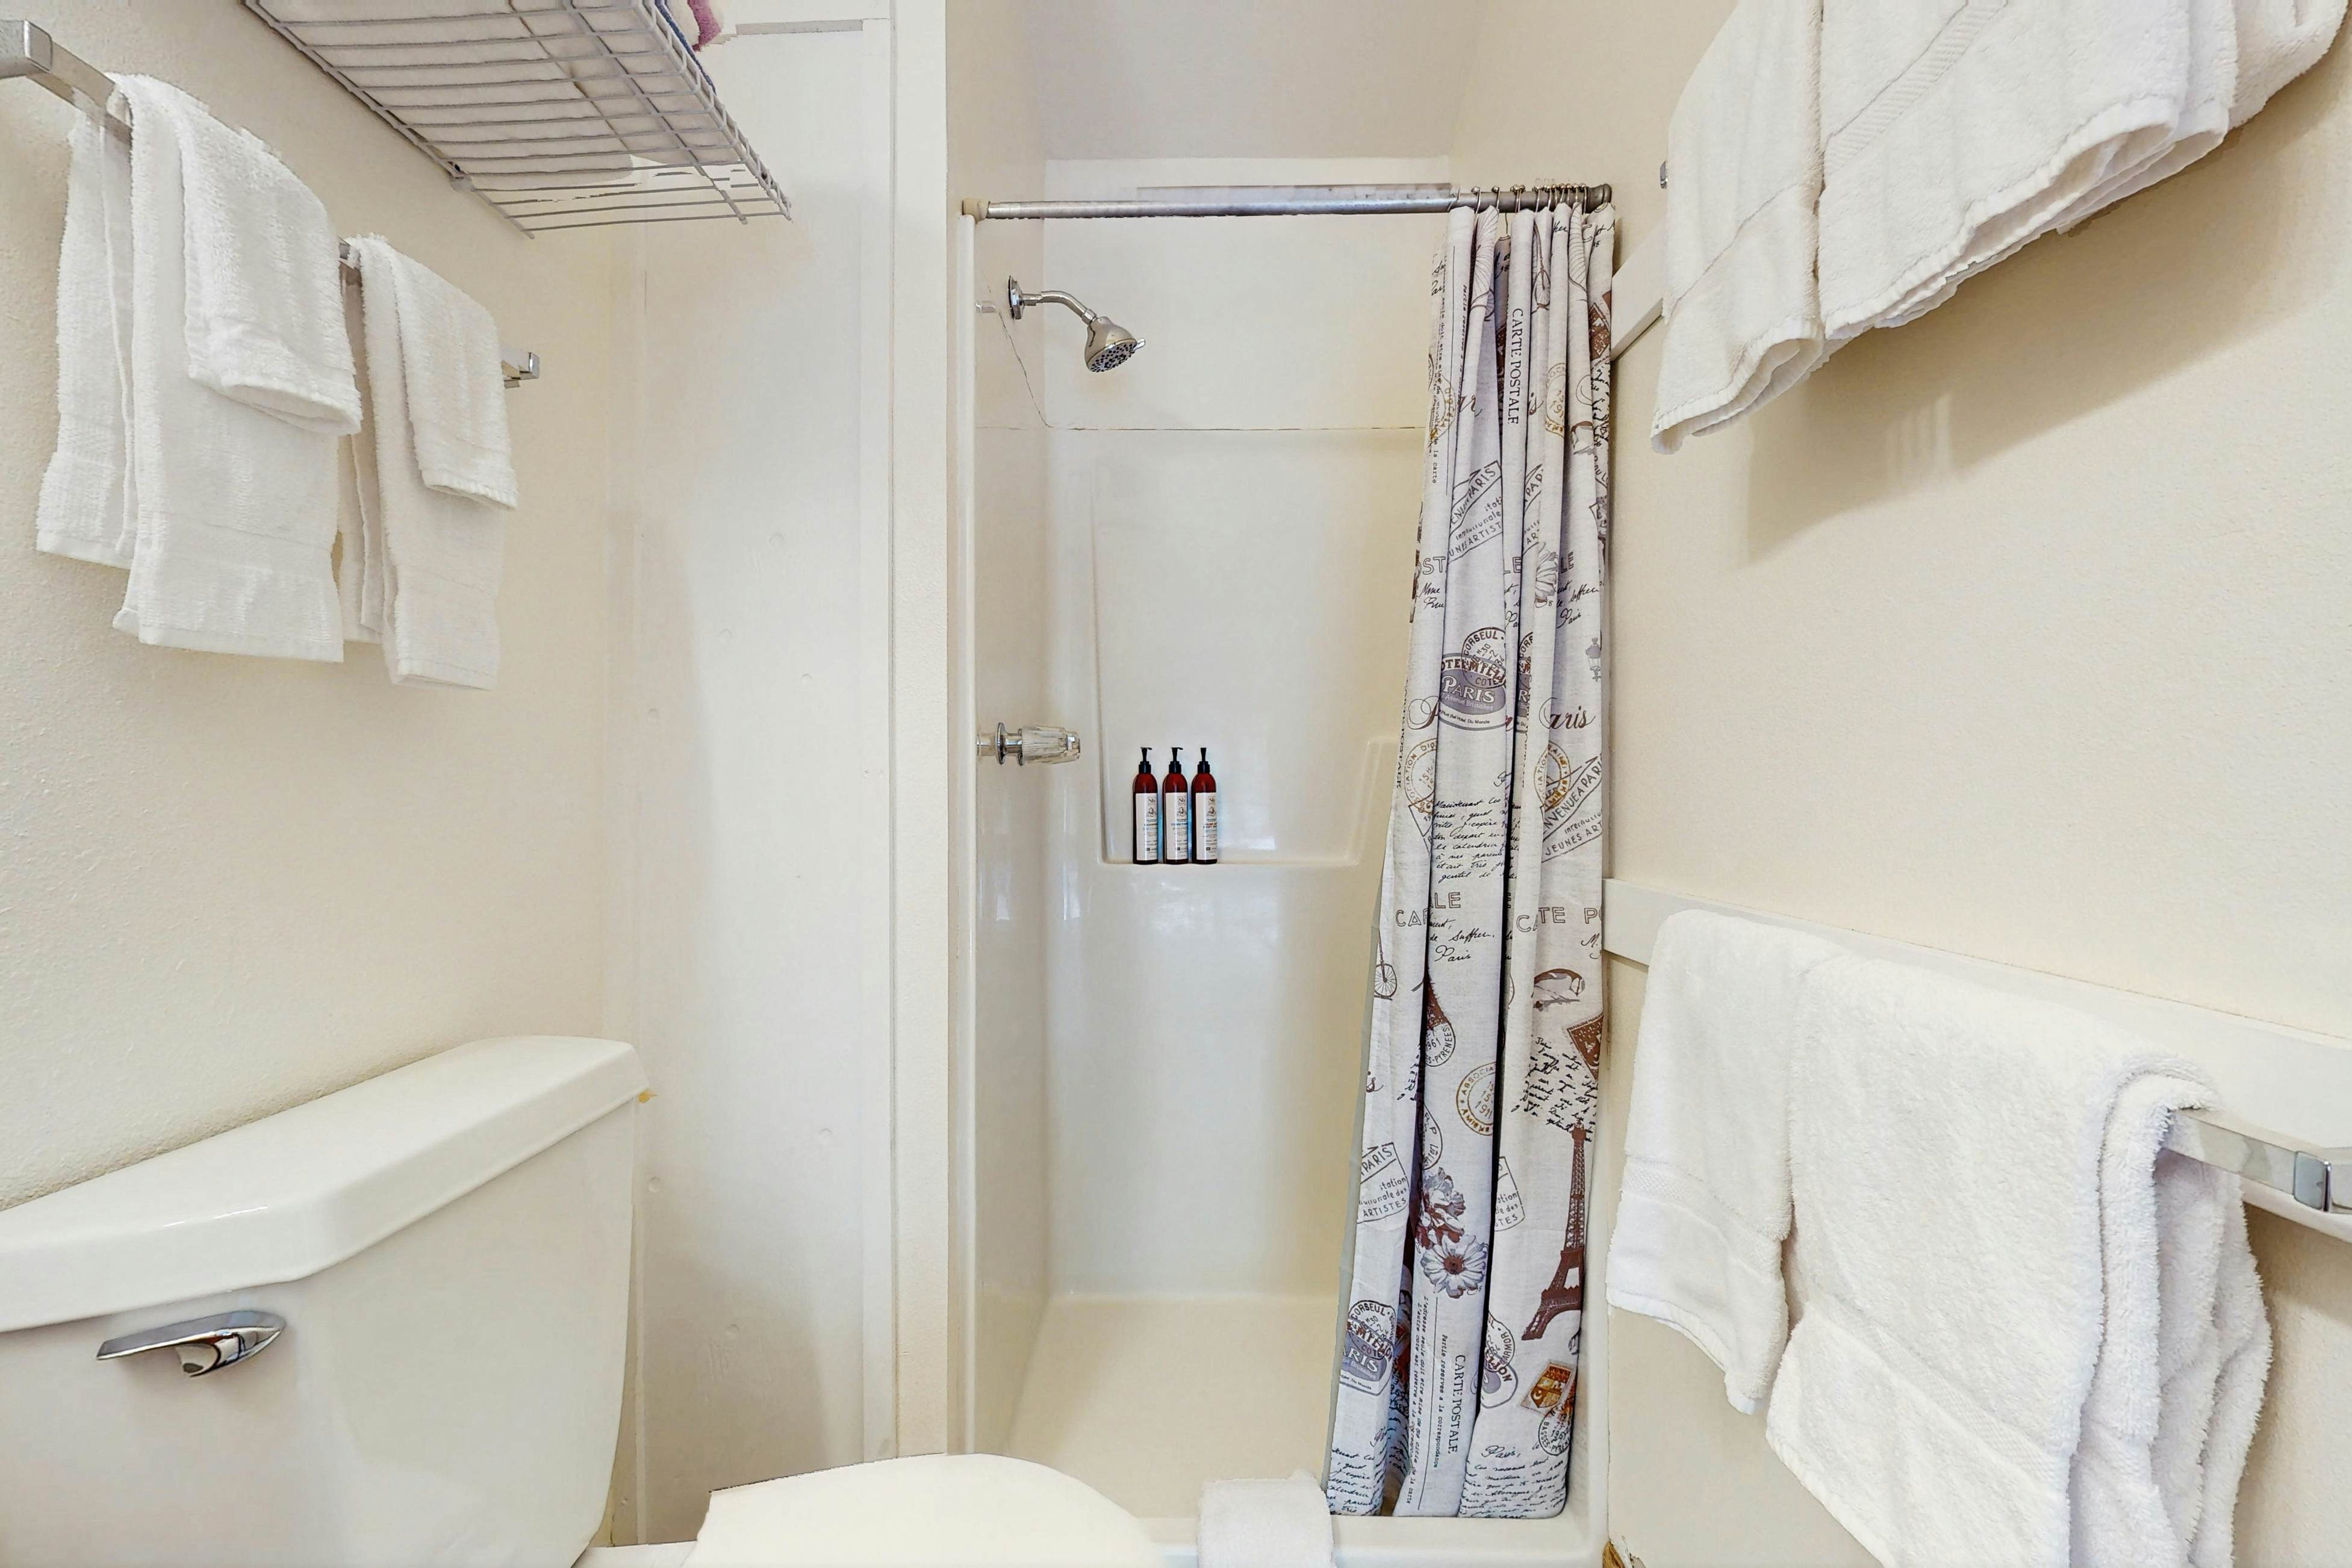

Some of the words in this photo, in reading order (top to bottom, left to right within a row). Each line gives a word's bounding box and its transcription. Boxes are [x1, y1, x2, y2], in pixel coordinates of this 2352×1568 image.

[1511, 308, 1524, 358] CARTE
[1507, 360, 1522, 425] POSTALE
[1467, 468, 1496, 499] PARIS
[1463, 630, 1499, 656] CORSEUL
[1442, 675, 1495, 703] PARIS
[1545, 833, 1582, 856] JEUNES
[1434, 944, 1472, 962] Paris
[1361, 1146, 1392, 1173] PARIS
[1363, 1198, 1407, 1218] ARTISTES
[1351, 1303, 1386, 1321] CORSEUL
[1452, 1354, 1466, 1397] CARTE
[1448, 1398, 1462, 1455] POSTALE
